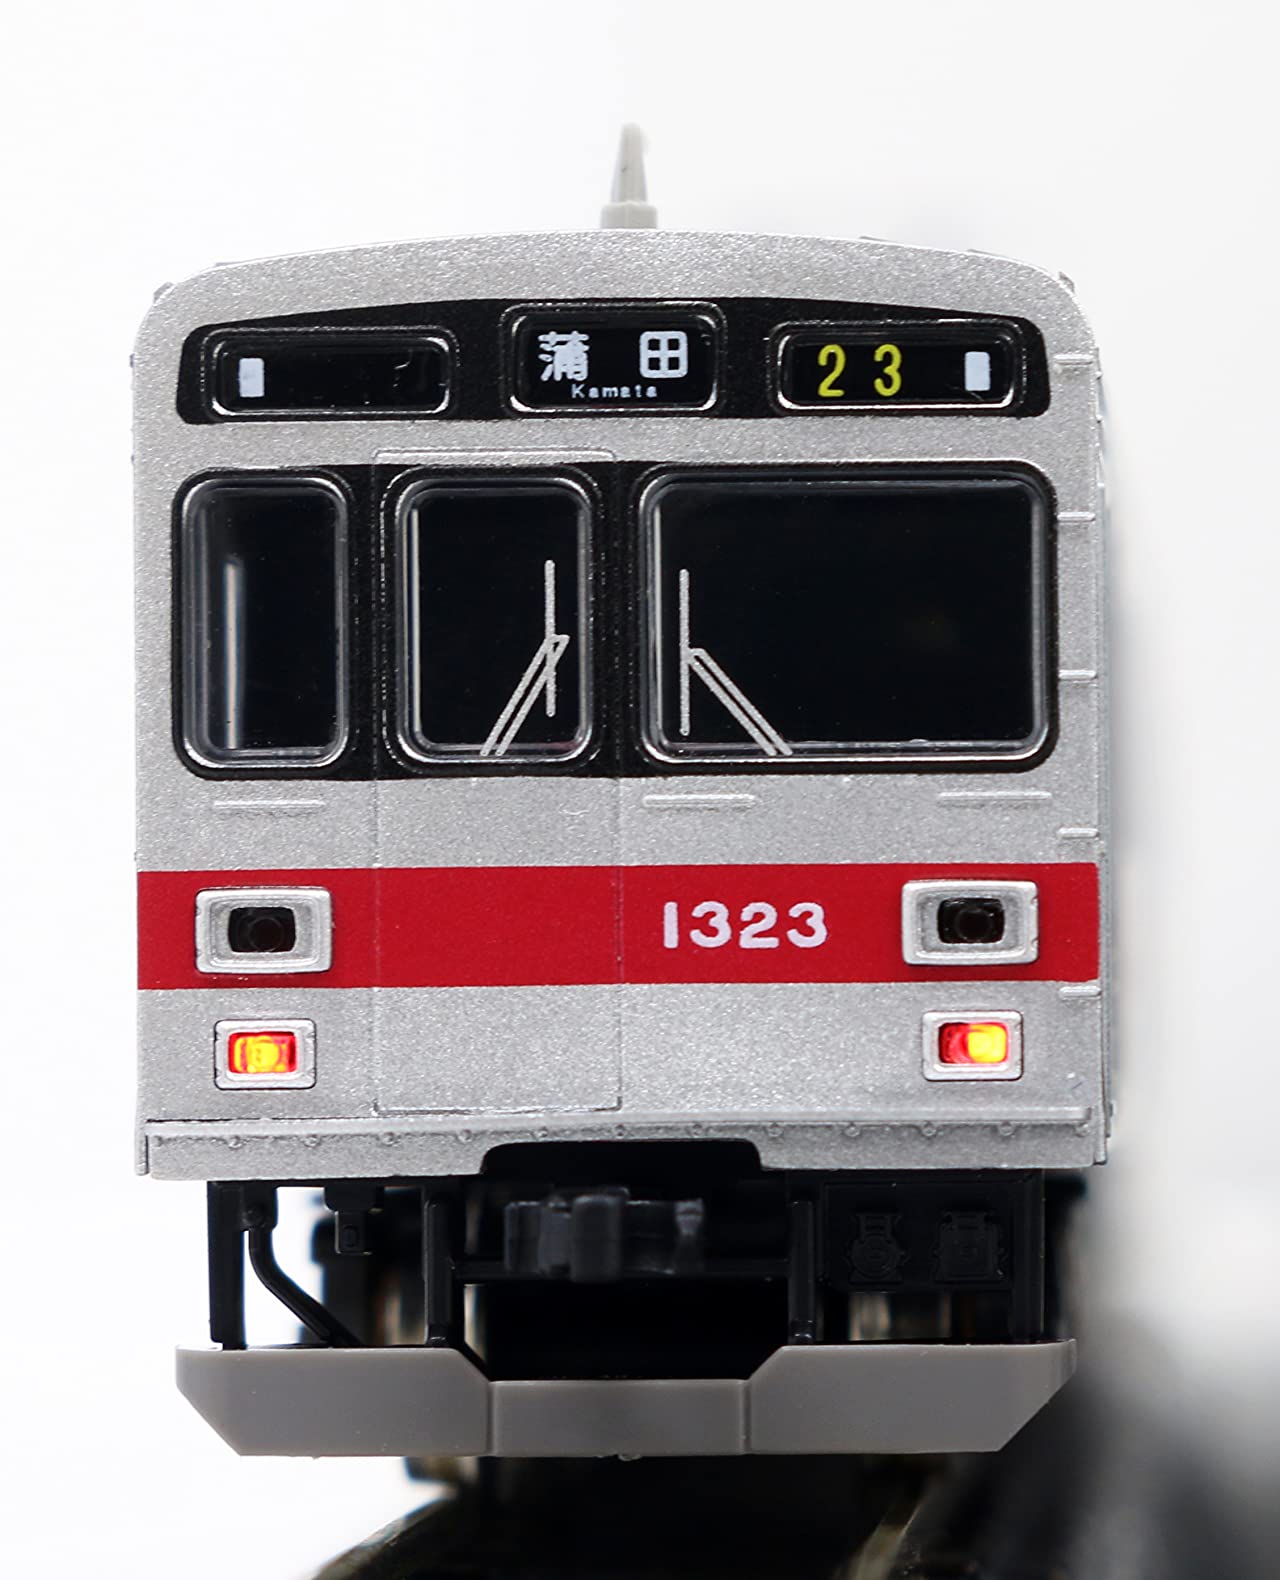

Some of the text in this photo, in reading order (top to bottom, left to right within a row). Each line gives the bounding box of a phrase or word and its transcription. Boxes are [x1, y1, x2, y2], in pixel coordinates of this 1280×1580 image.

[538, 330, 688, 382] 蒲田
[571, 384, 658, 399] Kamata
[662, 900, 828, 949] 1323
